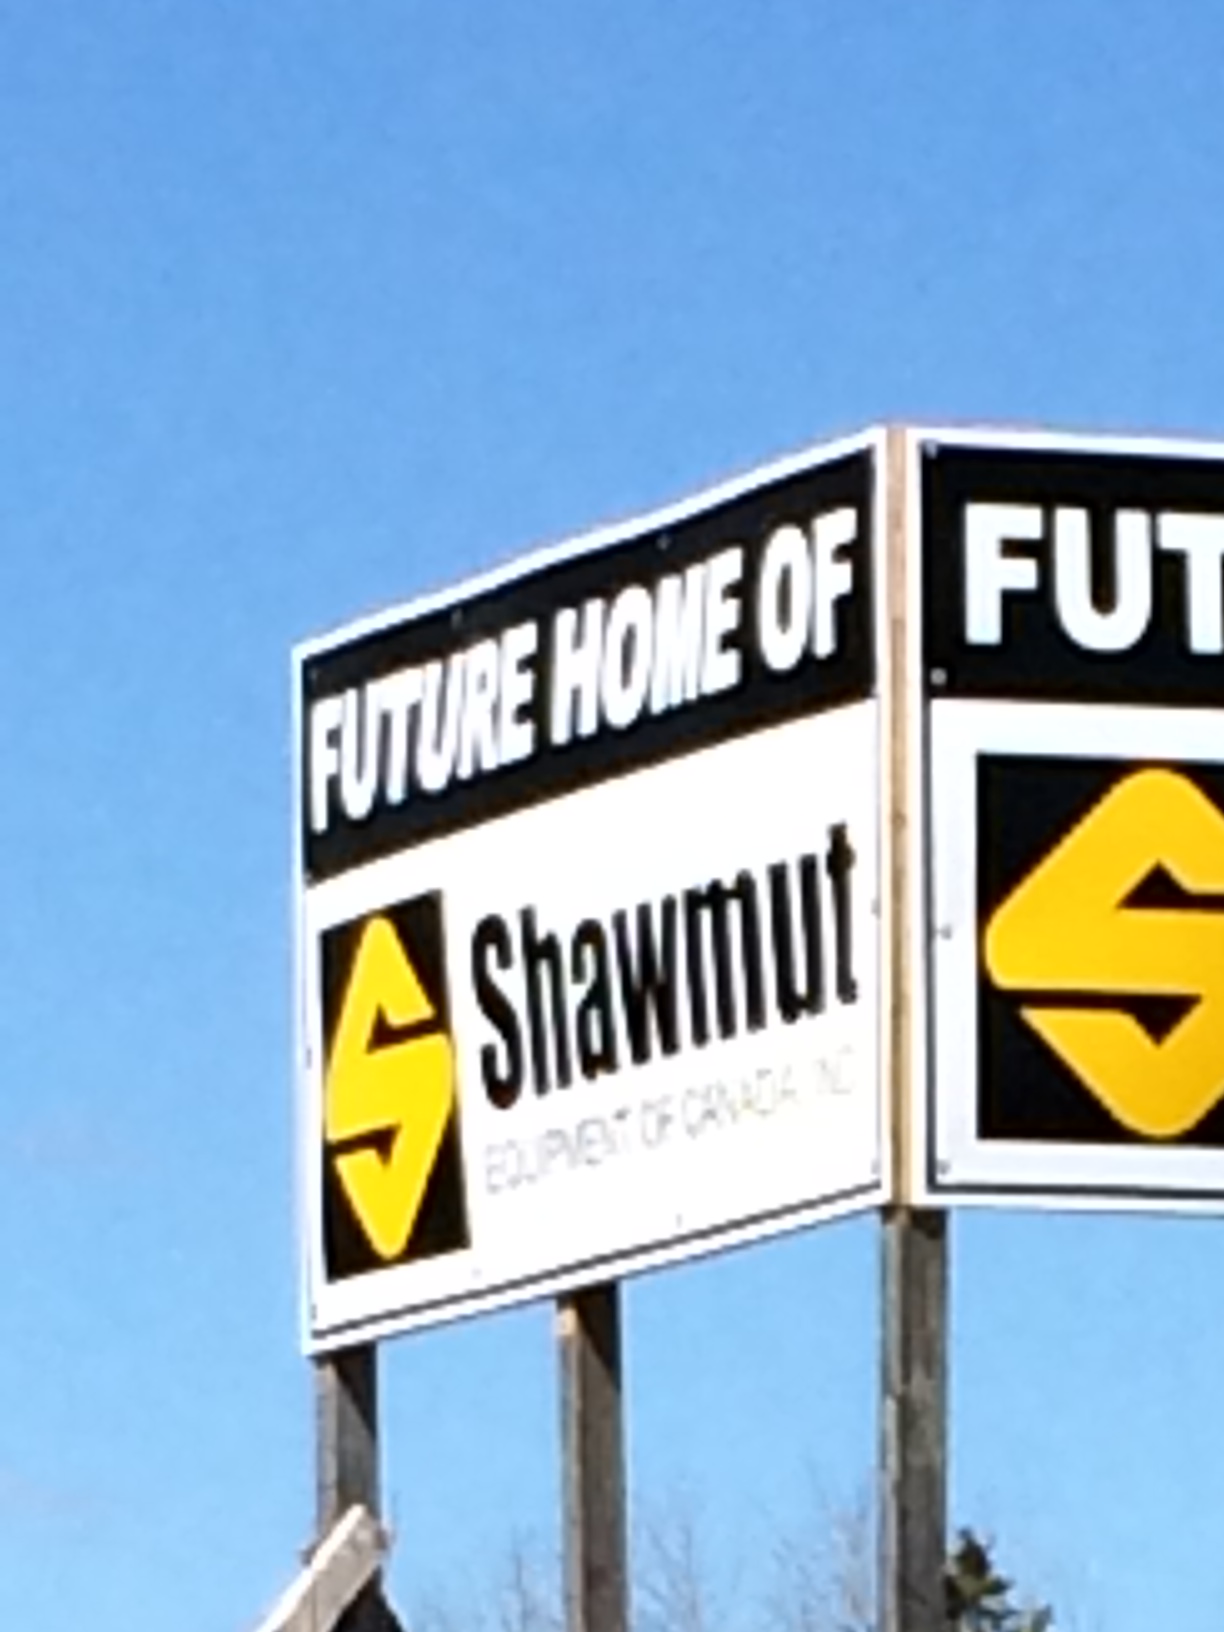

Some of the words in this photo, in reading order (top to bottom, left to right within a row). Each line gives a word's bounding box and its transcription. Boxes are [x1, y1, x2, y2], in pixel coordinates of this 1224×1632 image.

[308, 620, 539, 835] FUTURE
[551, 545, 745, 747] HOME
[758, 506, 858, 674] OF
[470, 822, 858, 1110] Shawmut
